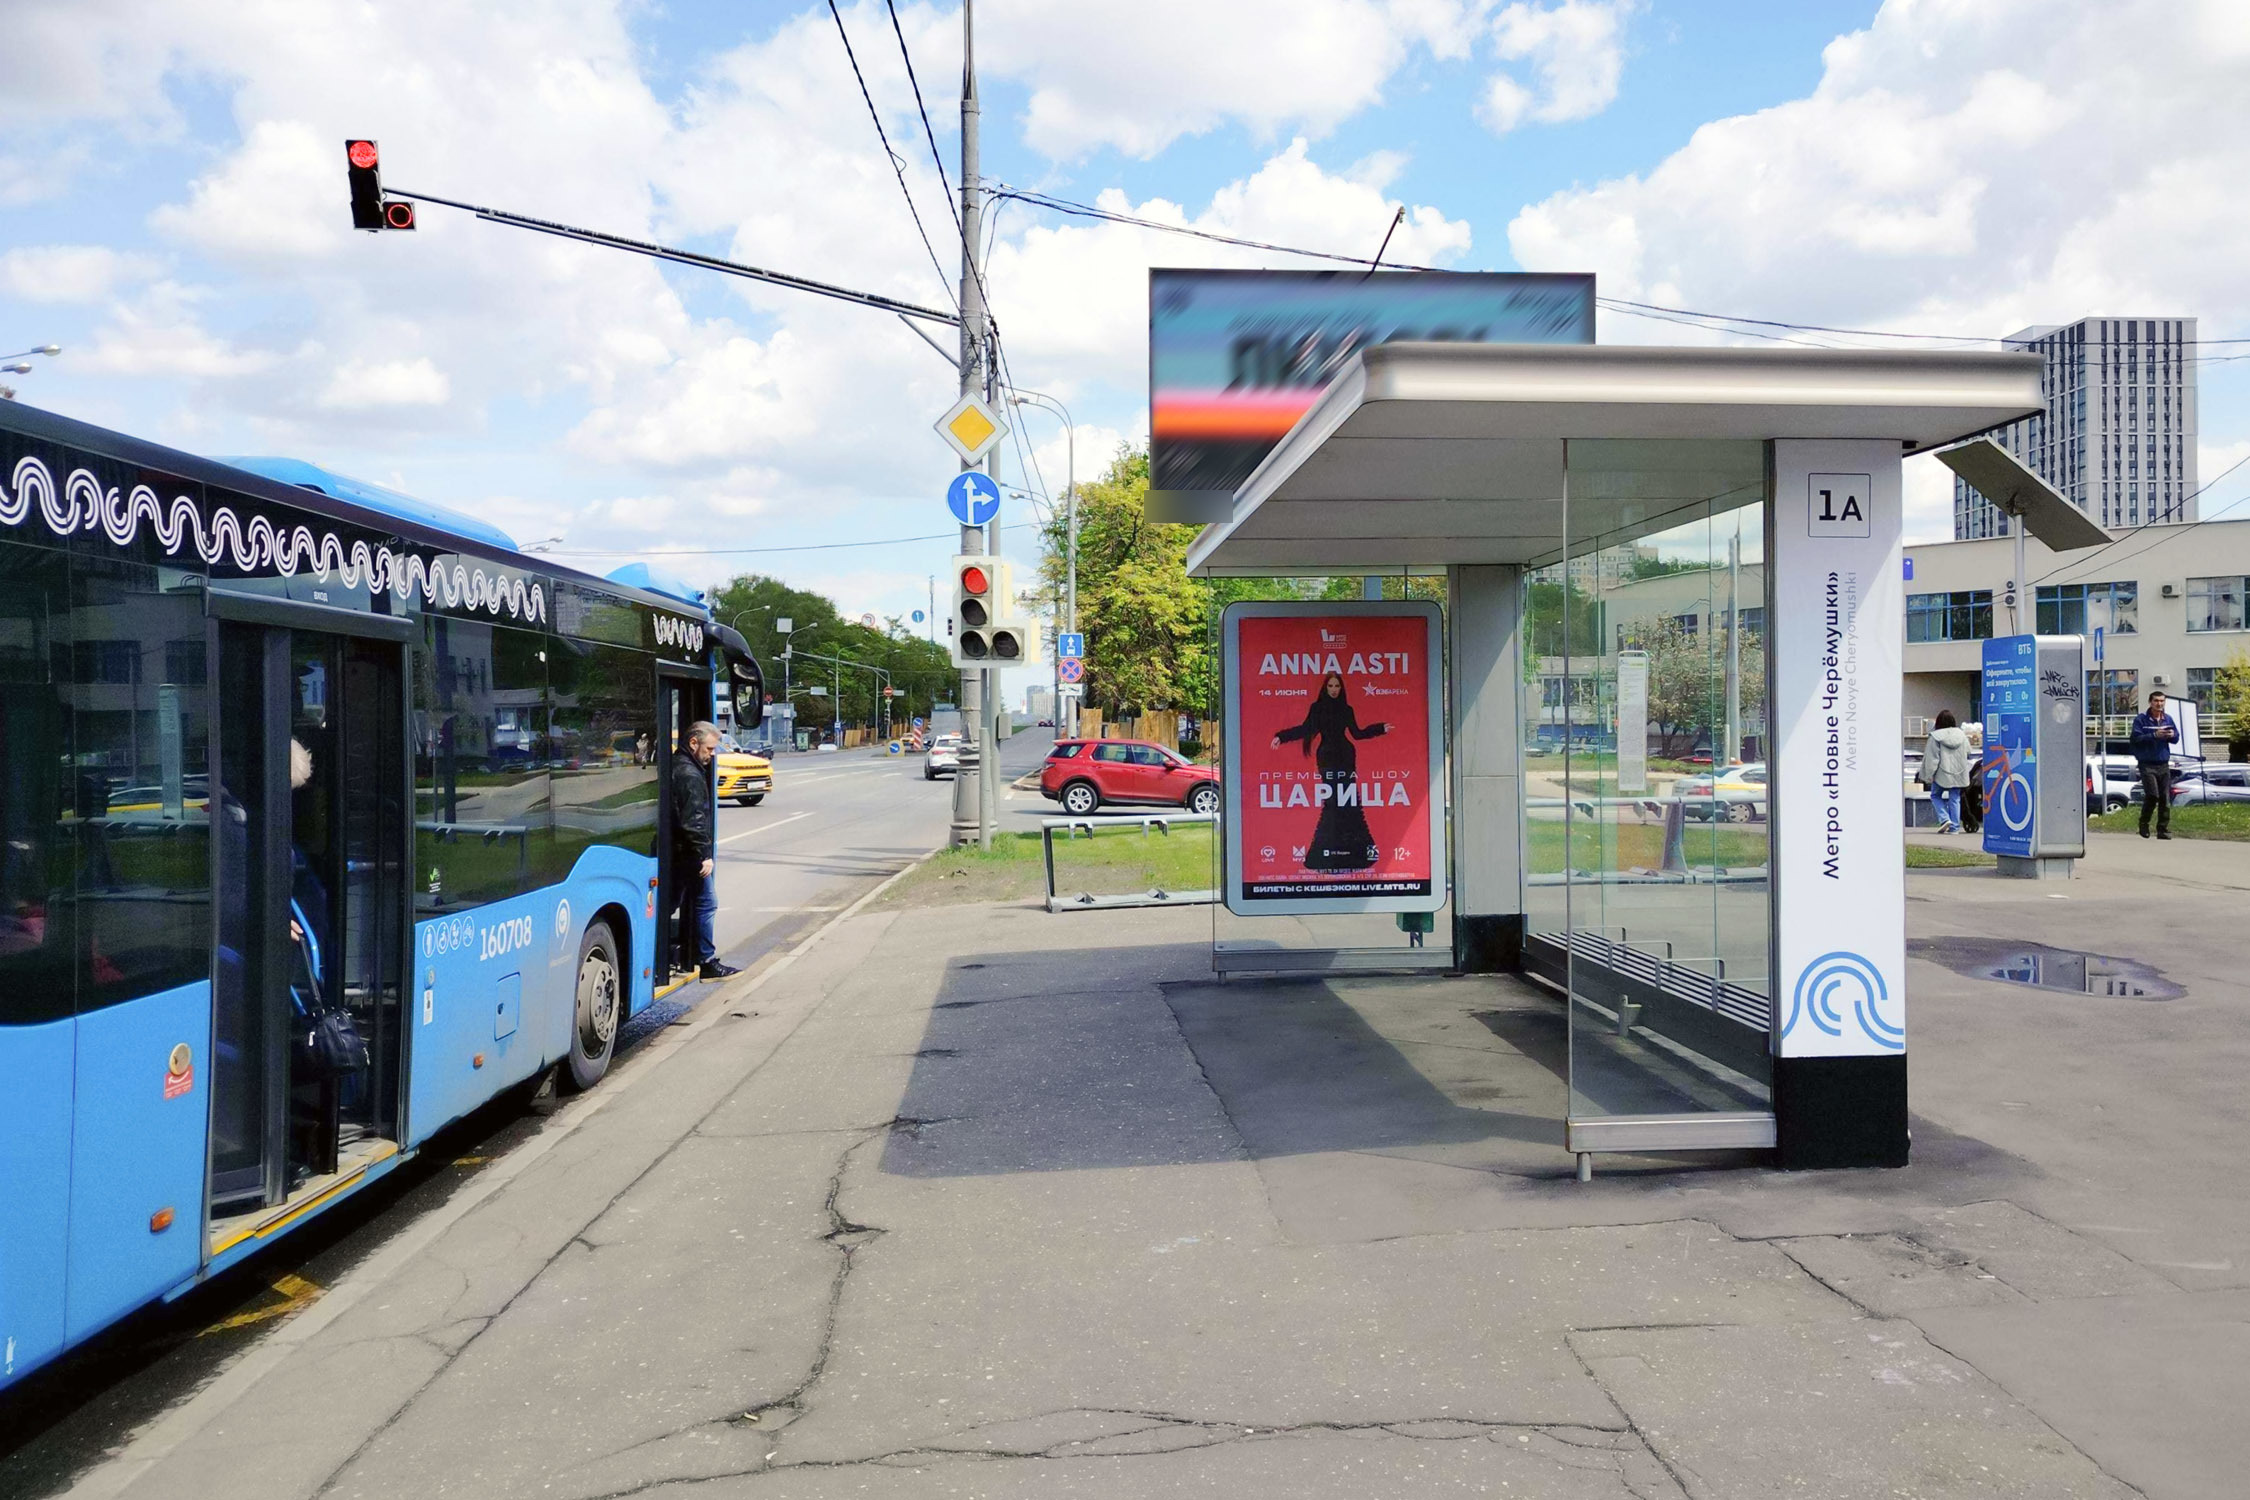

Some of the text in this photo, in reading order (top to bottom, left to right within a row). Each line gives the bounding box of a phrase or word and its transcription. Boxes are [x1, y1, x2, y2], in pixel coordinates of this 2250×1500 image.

[313, 591, 328, 602] ВХОД
[2018, 643, 2032, 655] ВТБ
[1258, 652, 1409, 675] ANNA ASTI
[2015, 665, 2032, 674] чтобы
[1845, 571, 1859, 771] Metro Novye Cheryomushki
[1822, 571, 1843, 880] Метро «Новые Черёмушки»
[1259, 770, 1411, 780] ПРЕМЬЕРА ШОУ
[1259, 782, 1411, 808] ЦАРИЦА
[1394, 847, 1411, 861] 12+
[1253, 885, 1294, 893] БИЛЕТЫ
[1304, 884, 1360, 892] КЕШБЭКОМ
[1361, 883, 1421, 891] LIVE.MTS.RU
[480, 915, 532, 962] 160708
